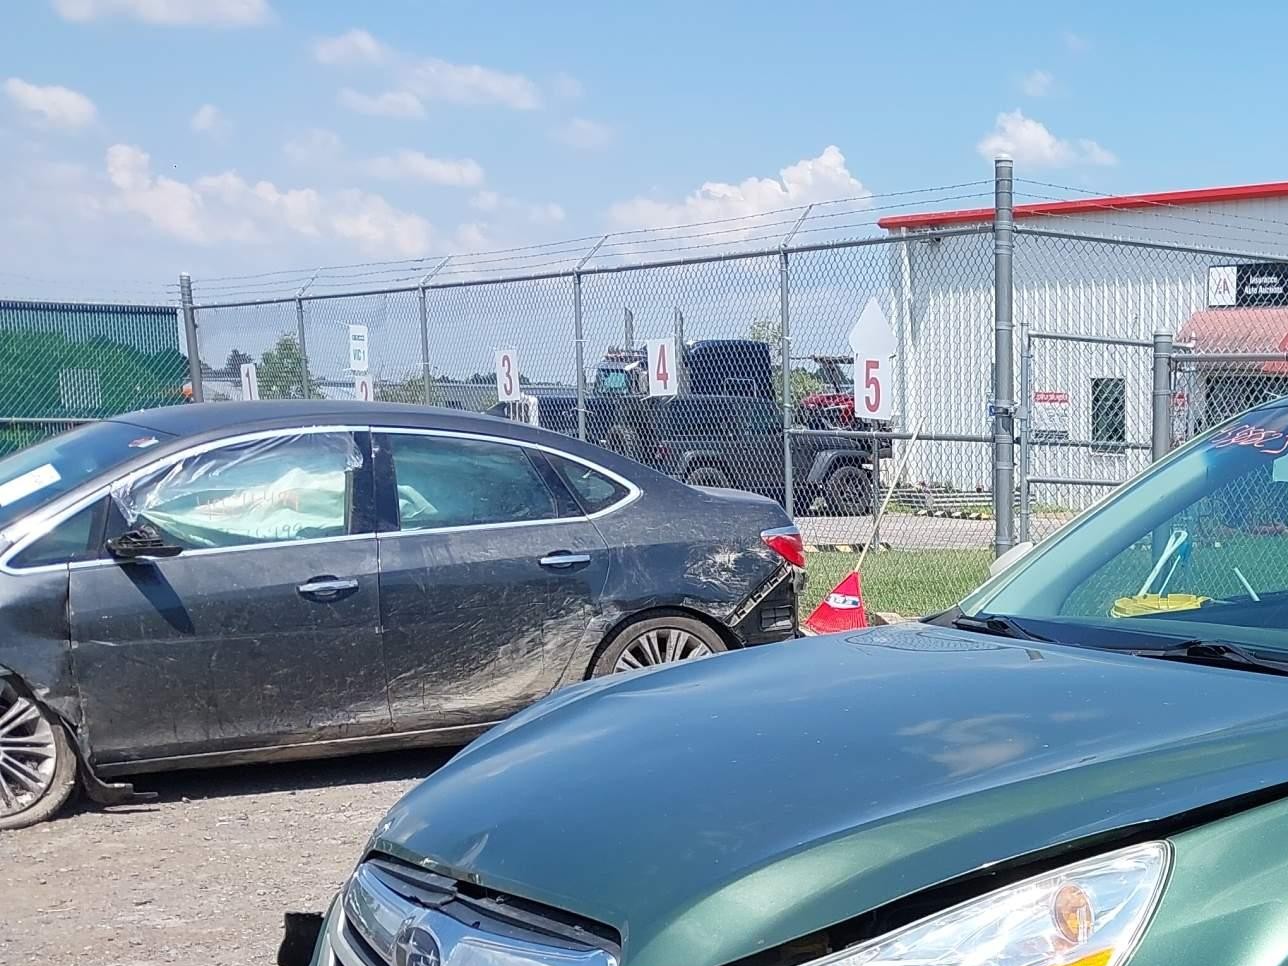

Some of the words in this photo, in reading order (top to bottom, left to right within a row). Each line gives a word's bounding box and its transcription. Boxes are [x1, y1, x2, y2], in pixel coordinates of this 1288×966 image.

[245, 367, 253, 401] 1
[502, 354, 513, 396] 3
[657, 344, 669, 390] 4
[865, 360, 881, 413] 5
